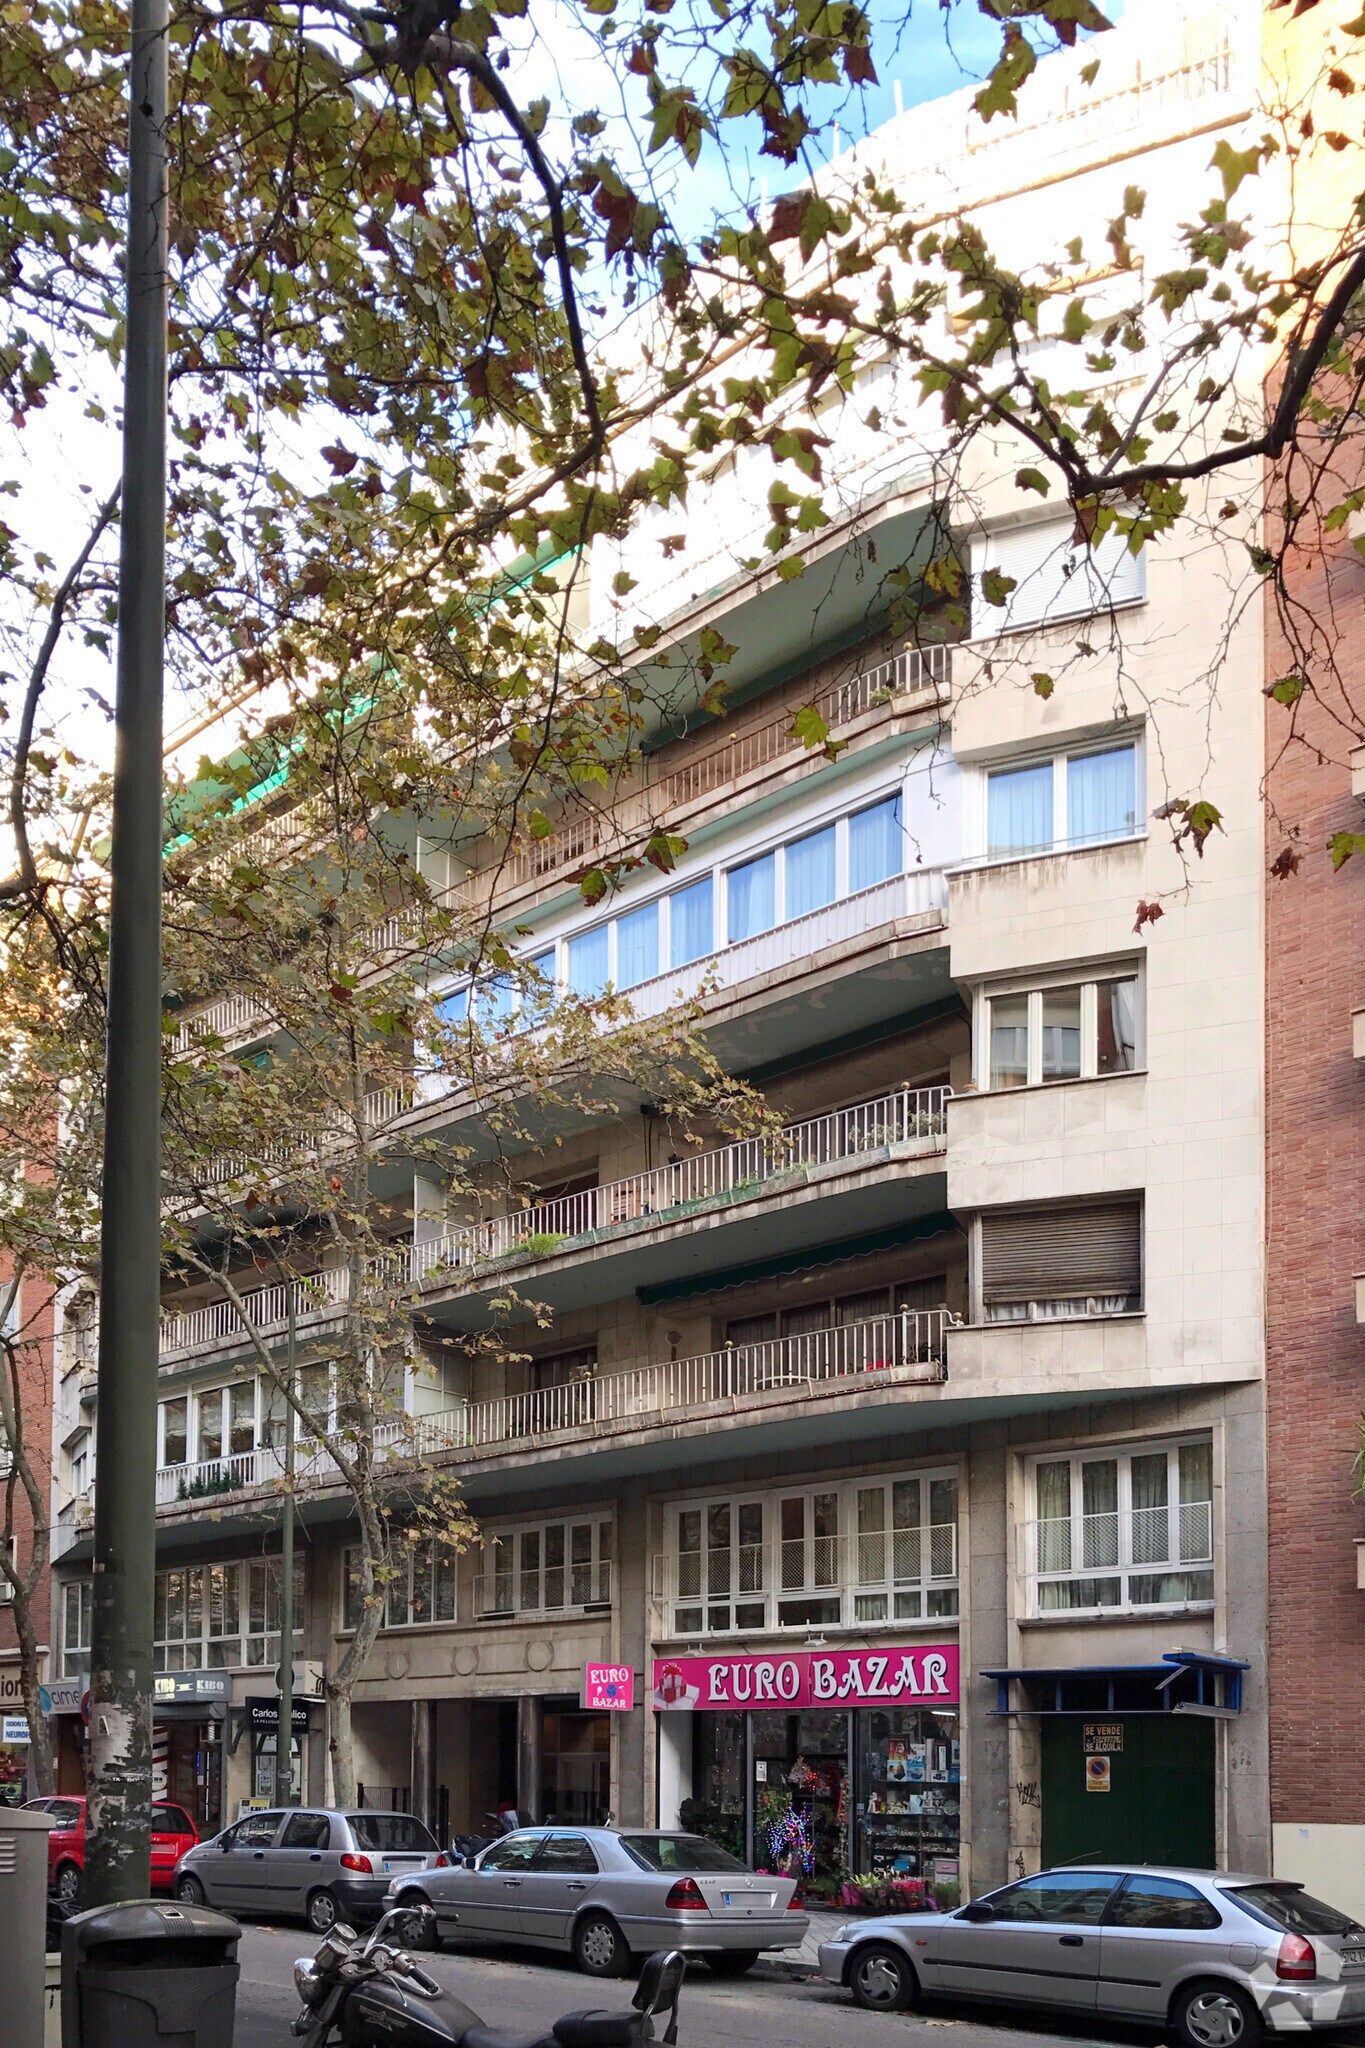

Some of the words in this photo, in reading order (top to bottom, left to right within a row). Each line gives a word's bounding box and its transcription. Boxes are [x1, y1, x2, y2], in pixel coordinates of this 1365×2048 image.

[590, 1668, 629, 1684] EURO
[707, 1660, 800, 1701] EURO
[812, 1653, 950, 1699] BAZAR
[197, 1680, 224, 1690] KIBO
[592, 1696, 627, 1709] BAZAR
[252, 1708, 279, 1718] Carlos
[1085, 1727, 1095, 1735] SE
[1097, 1727, 1121, 1735] VENDE
[1086, 1743, 1094, 1751] SE
[1095, 1743, 1121, 1751] ALQUILA
